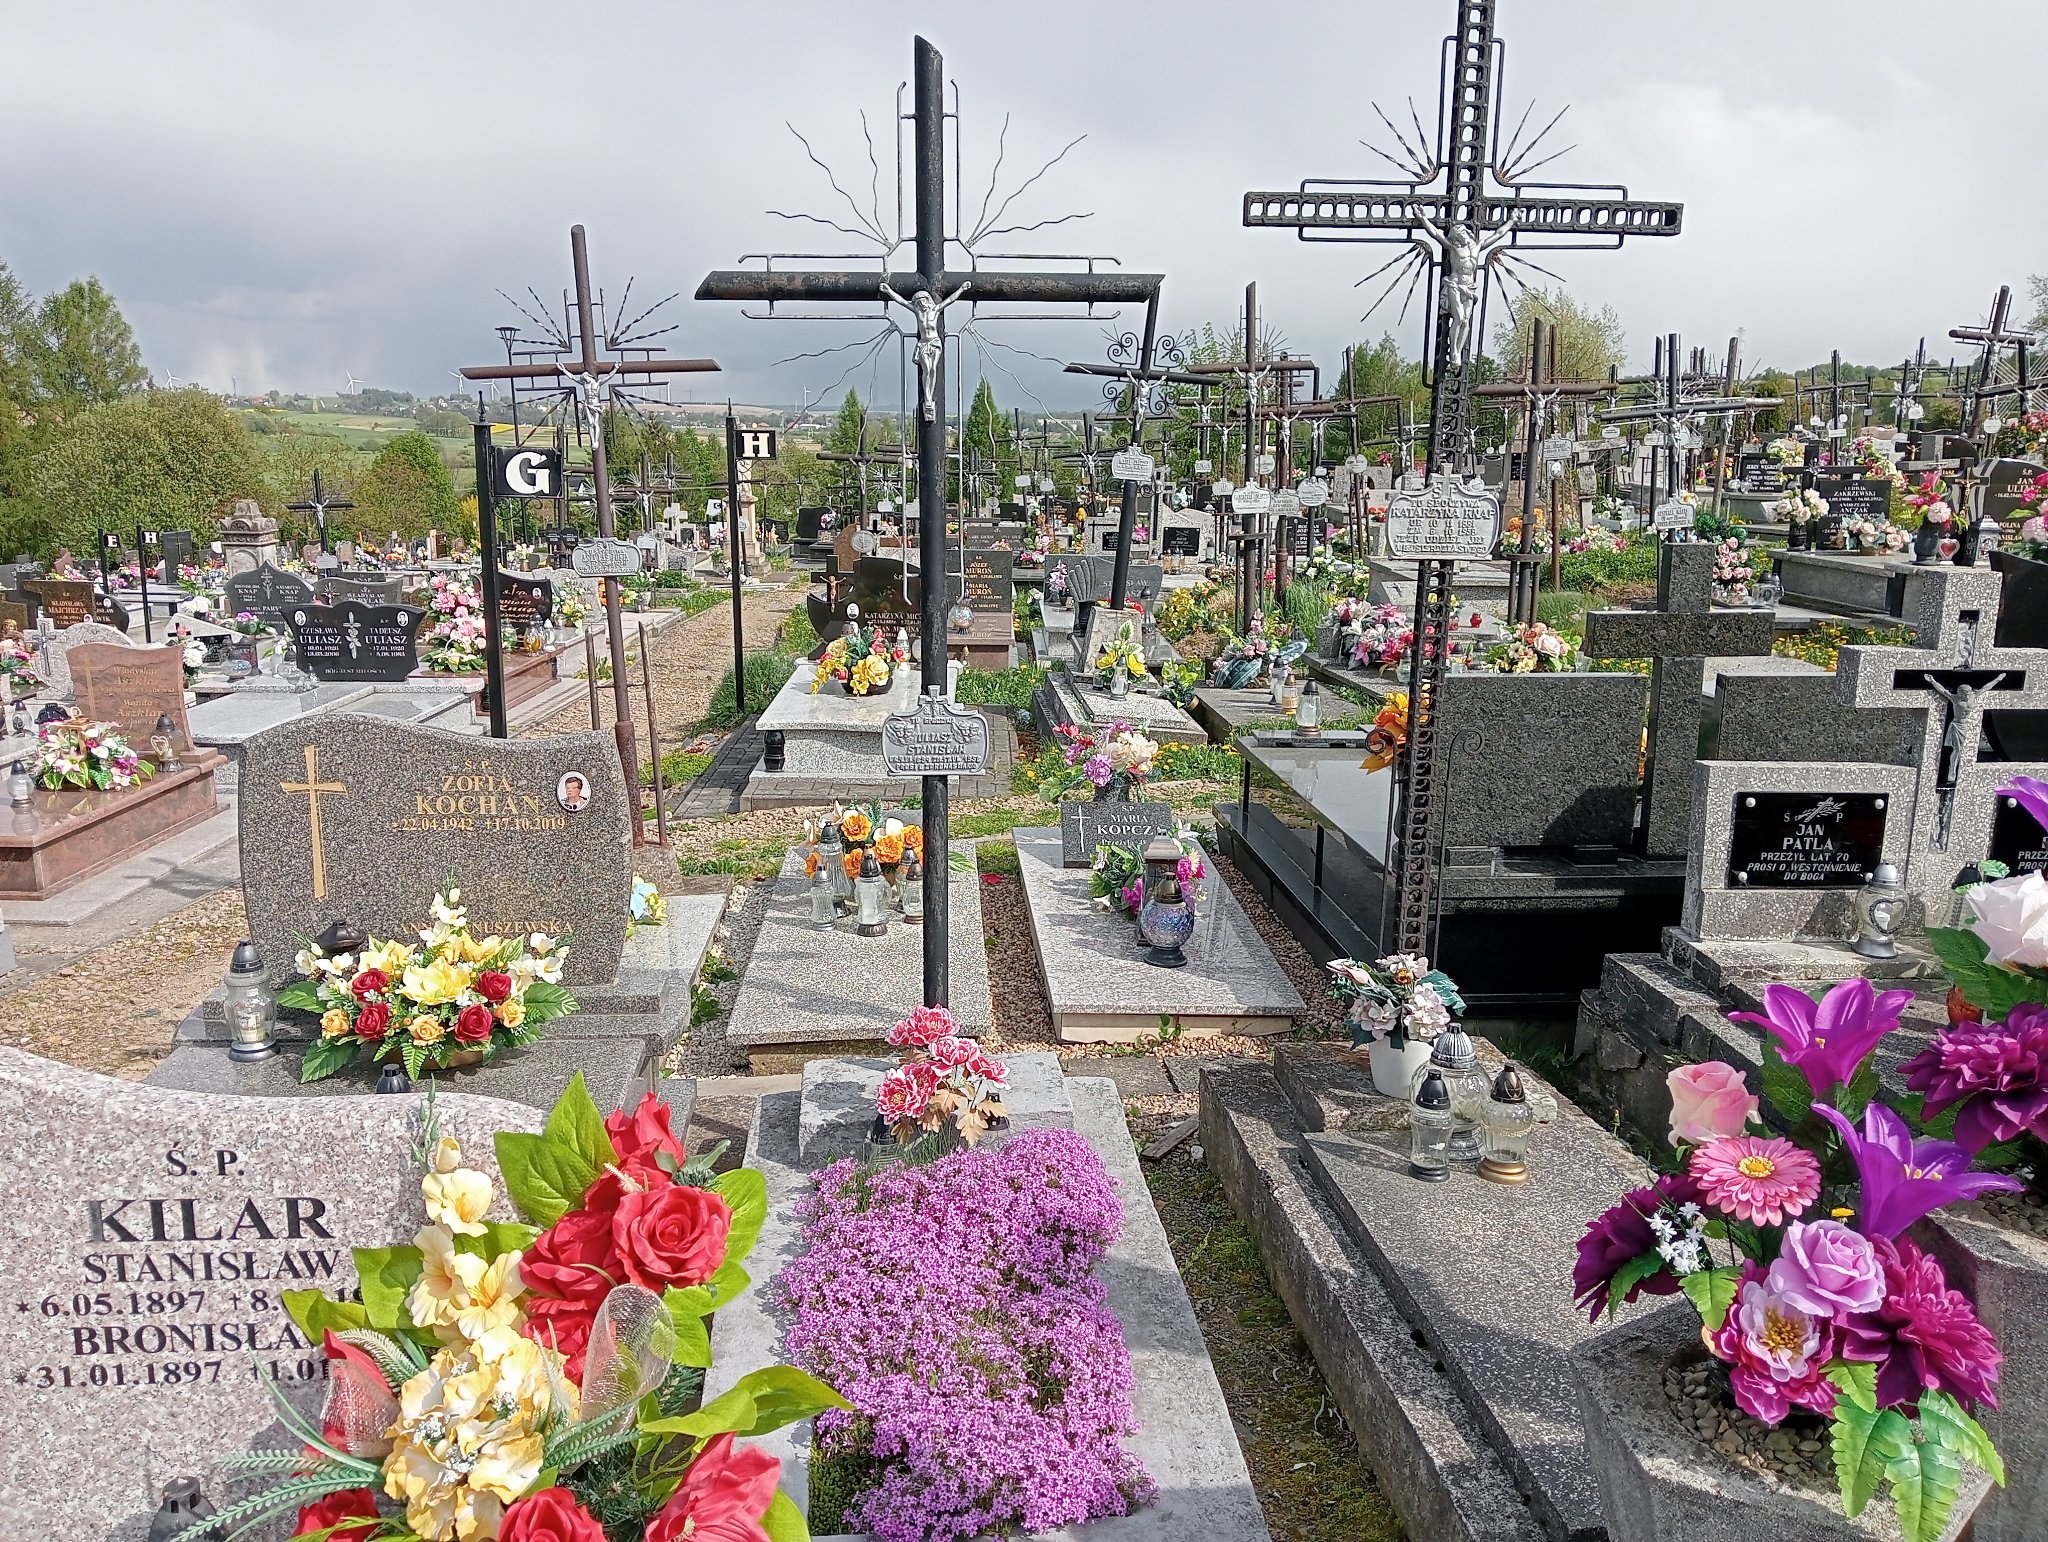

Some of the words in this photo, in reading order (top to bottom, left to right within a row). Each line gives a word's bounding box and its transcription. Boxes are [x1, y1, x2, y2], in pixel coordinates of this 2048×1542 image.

[742, 433, 771, 457] H
[506, 452, 550, 494] G
[1391, 507, 1459, 518] KATARZYNA
[1463, 508, 1495, 519] KNAP
[107, 535, 118, 547] E
[144, 531, 158, 543] H
[299, 635, 342, 645] ULIASZ
[365, 635, 407, 645] ULIASZ
[917, 732, 953, 743] ULIASZ
[442, 775, 511, 792] ZOFIA
[415, 795, 543, 815] KOCHAN
[1110, 815, 1148, 823] MARIA
[1836, 812, 1844, 822] P
[1097, 825, 1154, 835] KOPCZ
[1795, 824, 1825, 836] JAN
[1782, 837, 1833, 850] PATLA
[1760, 851, 1806, 861] PRZEŻYŁ
[1811, 852, 1831, 861] LAT
[1836, 852, 1849, 861] 70
[1747, 863, 1777, 871] PROSI
[1779, 863, 1786, 871] O
[2017, 862, 2048, 870] PROSI
[467, 920, 574, 934] NUSZEWSKA
[87, 1197, 335, 1243] KILAR
[84, 1249, 340, 1285] STANISŁAW
[72, 1323, 306, 1356] BRONISŁA
